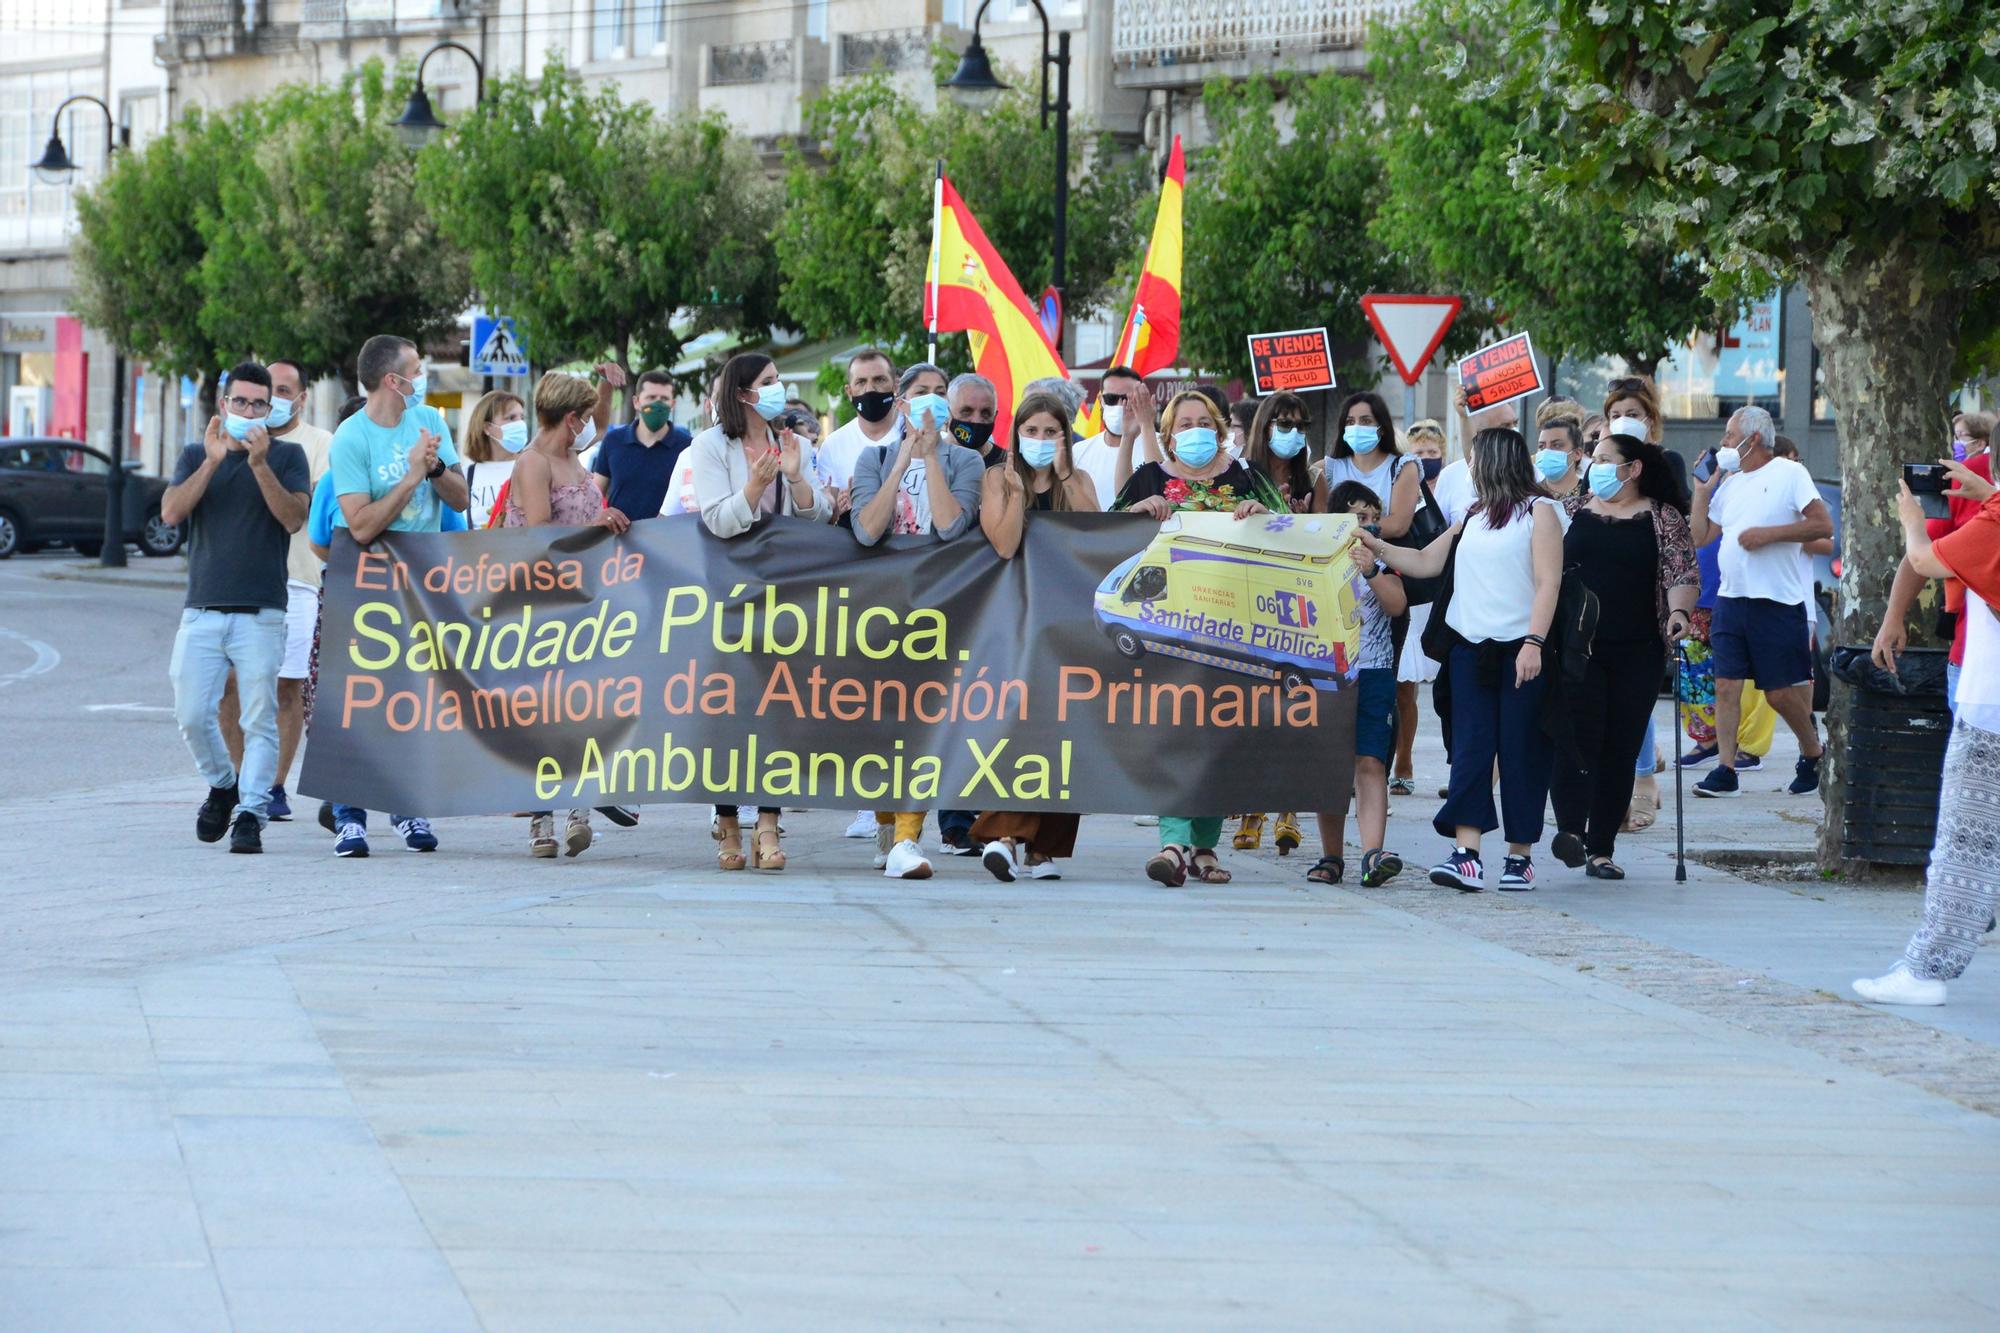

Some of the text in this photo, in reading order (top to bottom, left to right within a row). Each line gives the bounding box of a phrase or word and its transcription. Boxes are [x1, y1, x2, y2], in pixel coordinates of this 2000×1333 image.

[1253, 333, 1324, 357] SE VENDE
[1462, 338, 1528, 378] SE VENDE
[1274, 354, 1322, 369] NUESTRA
[1282, 372, 1318, 384] SALUD
[355, 546, 644, 594] En defensa da
[1296, 577, 1313, 588] SVB
[1192, 586, 1235, 599] URXENCIAS
[1193, 594, 1236, 608] SANITARIAS
[349, 584, 970, 671] Sanidade Pública.
[1139, 598, 1244, 641] Sanidade
[1251, 624, 1328, 659] Pública
[664, 659, 736, 716] da
[756, 661, 1028, 723] Atención
[1058, 666, 1319, 727] Primaria
[536, 732, 1073, 800] e Ambulancia Xa!
